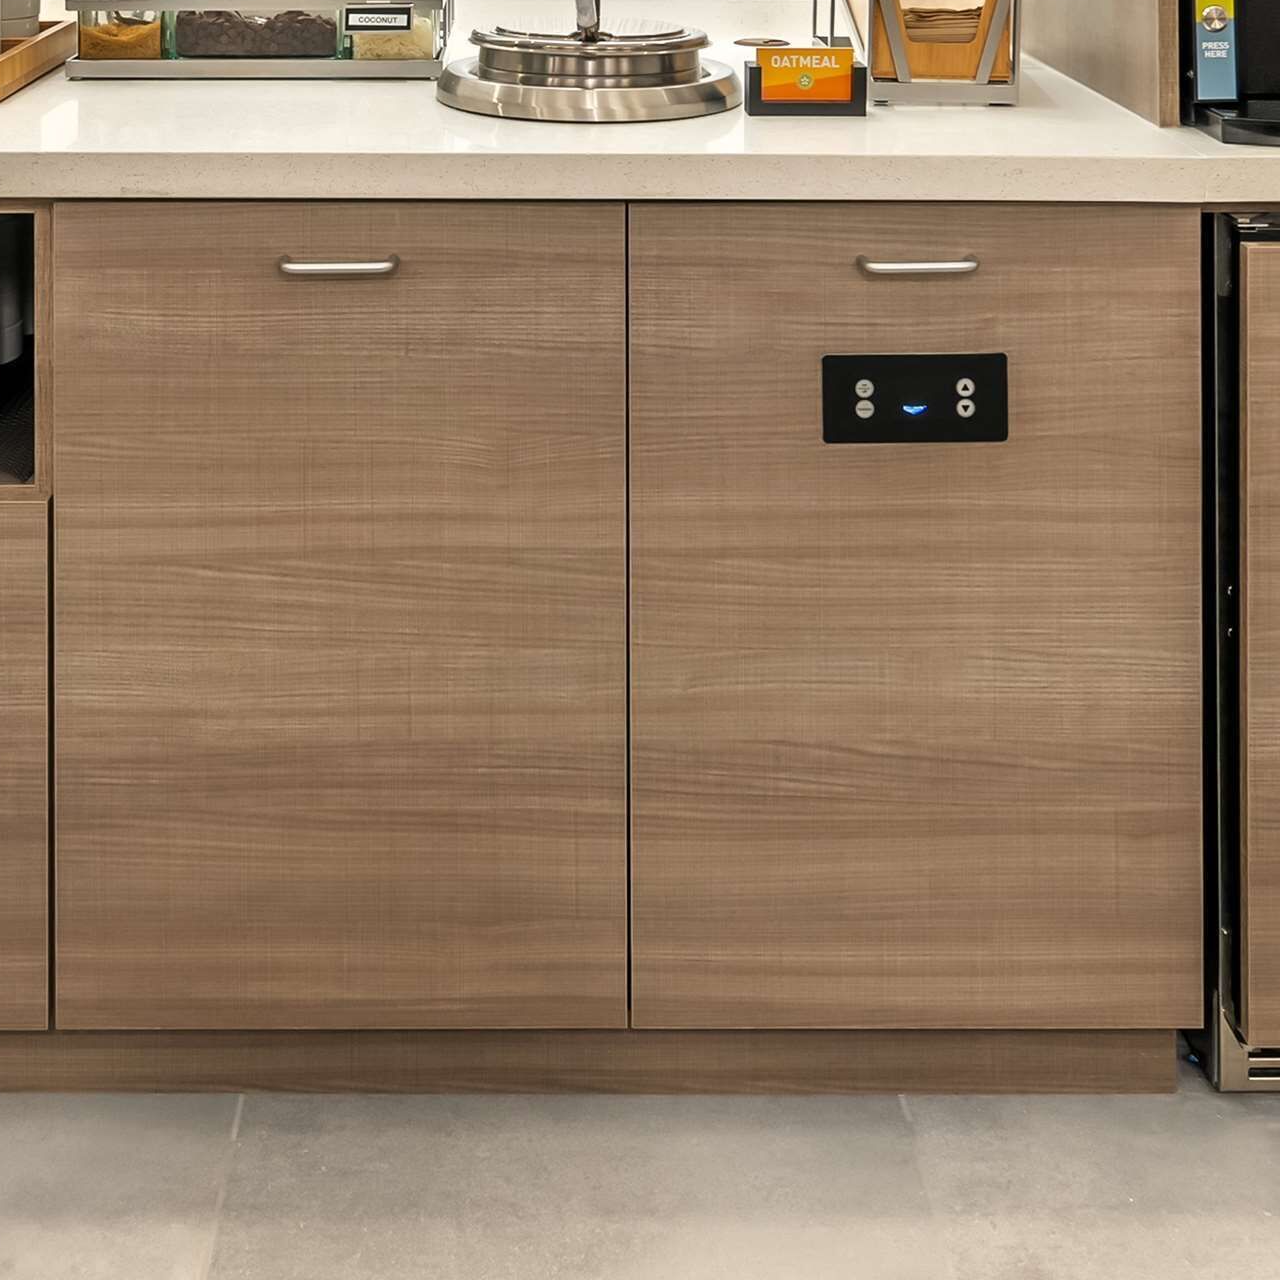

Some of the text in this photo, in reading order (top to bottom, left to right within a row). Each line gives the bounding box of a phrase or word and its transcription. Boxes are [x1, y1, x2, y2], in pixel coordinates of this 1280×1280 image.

[358, 16, 399, 24] COCONUT
[1201, 41, 1230, 50] PRESS
[1204, 50, 1228, 58] HERE
[770, 55, 841, 69] OATMEAL
